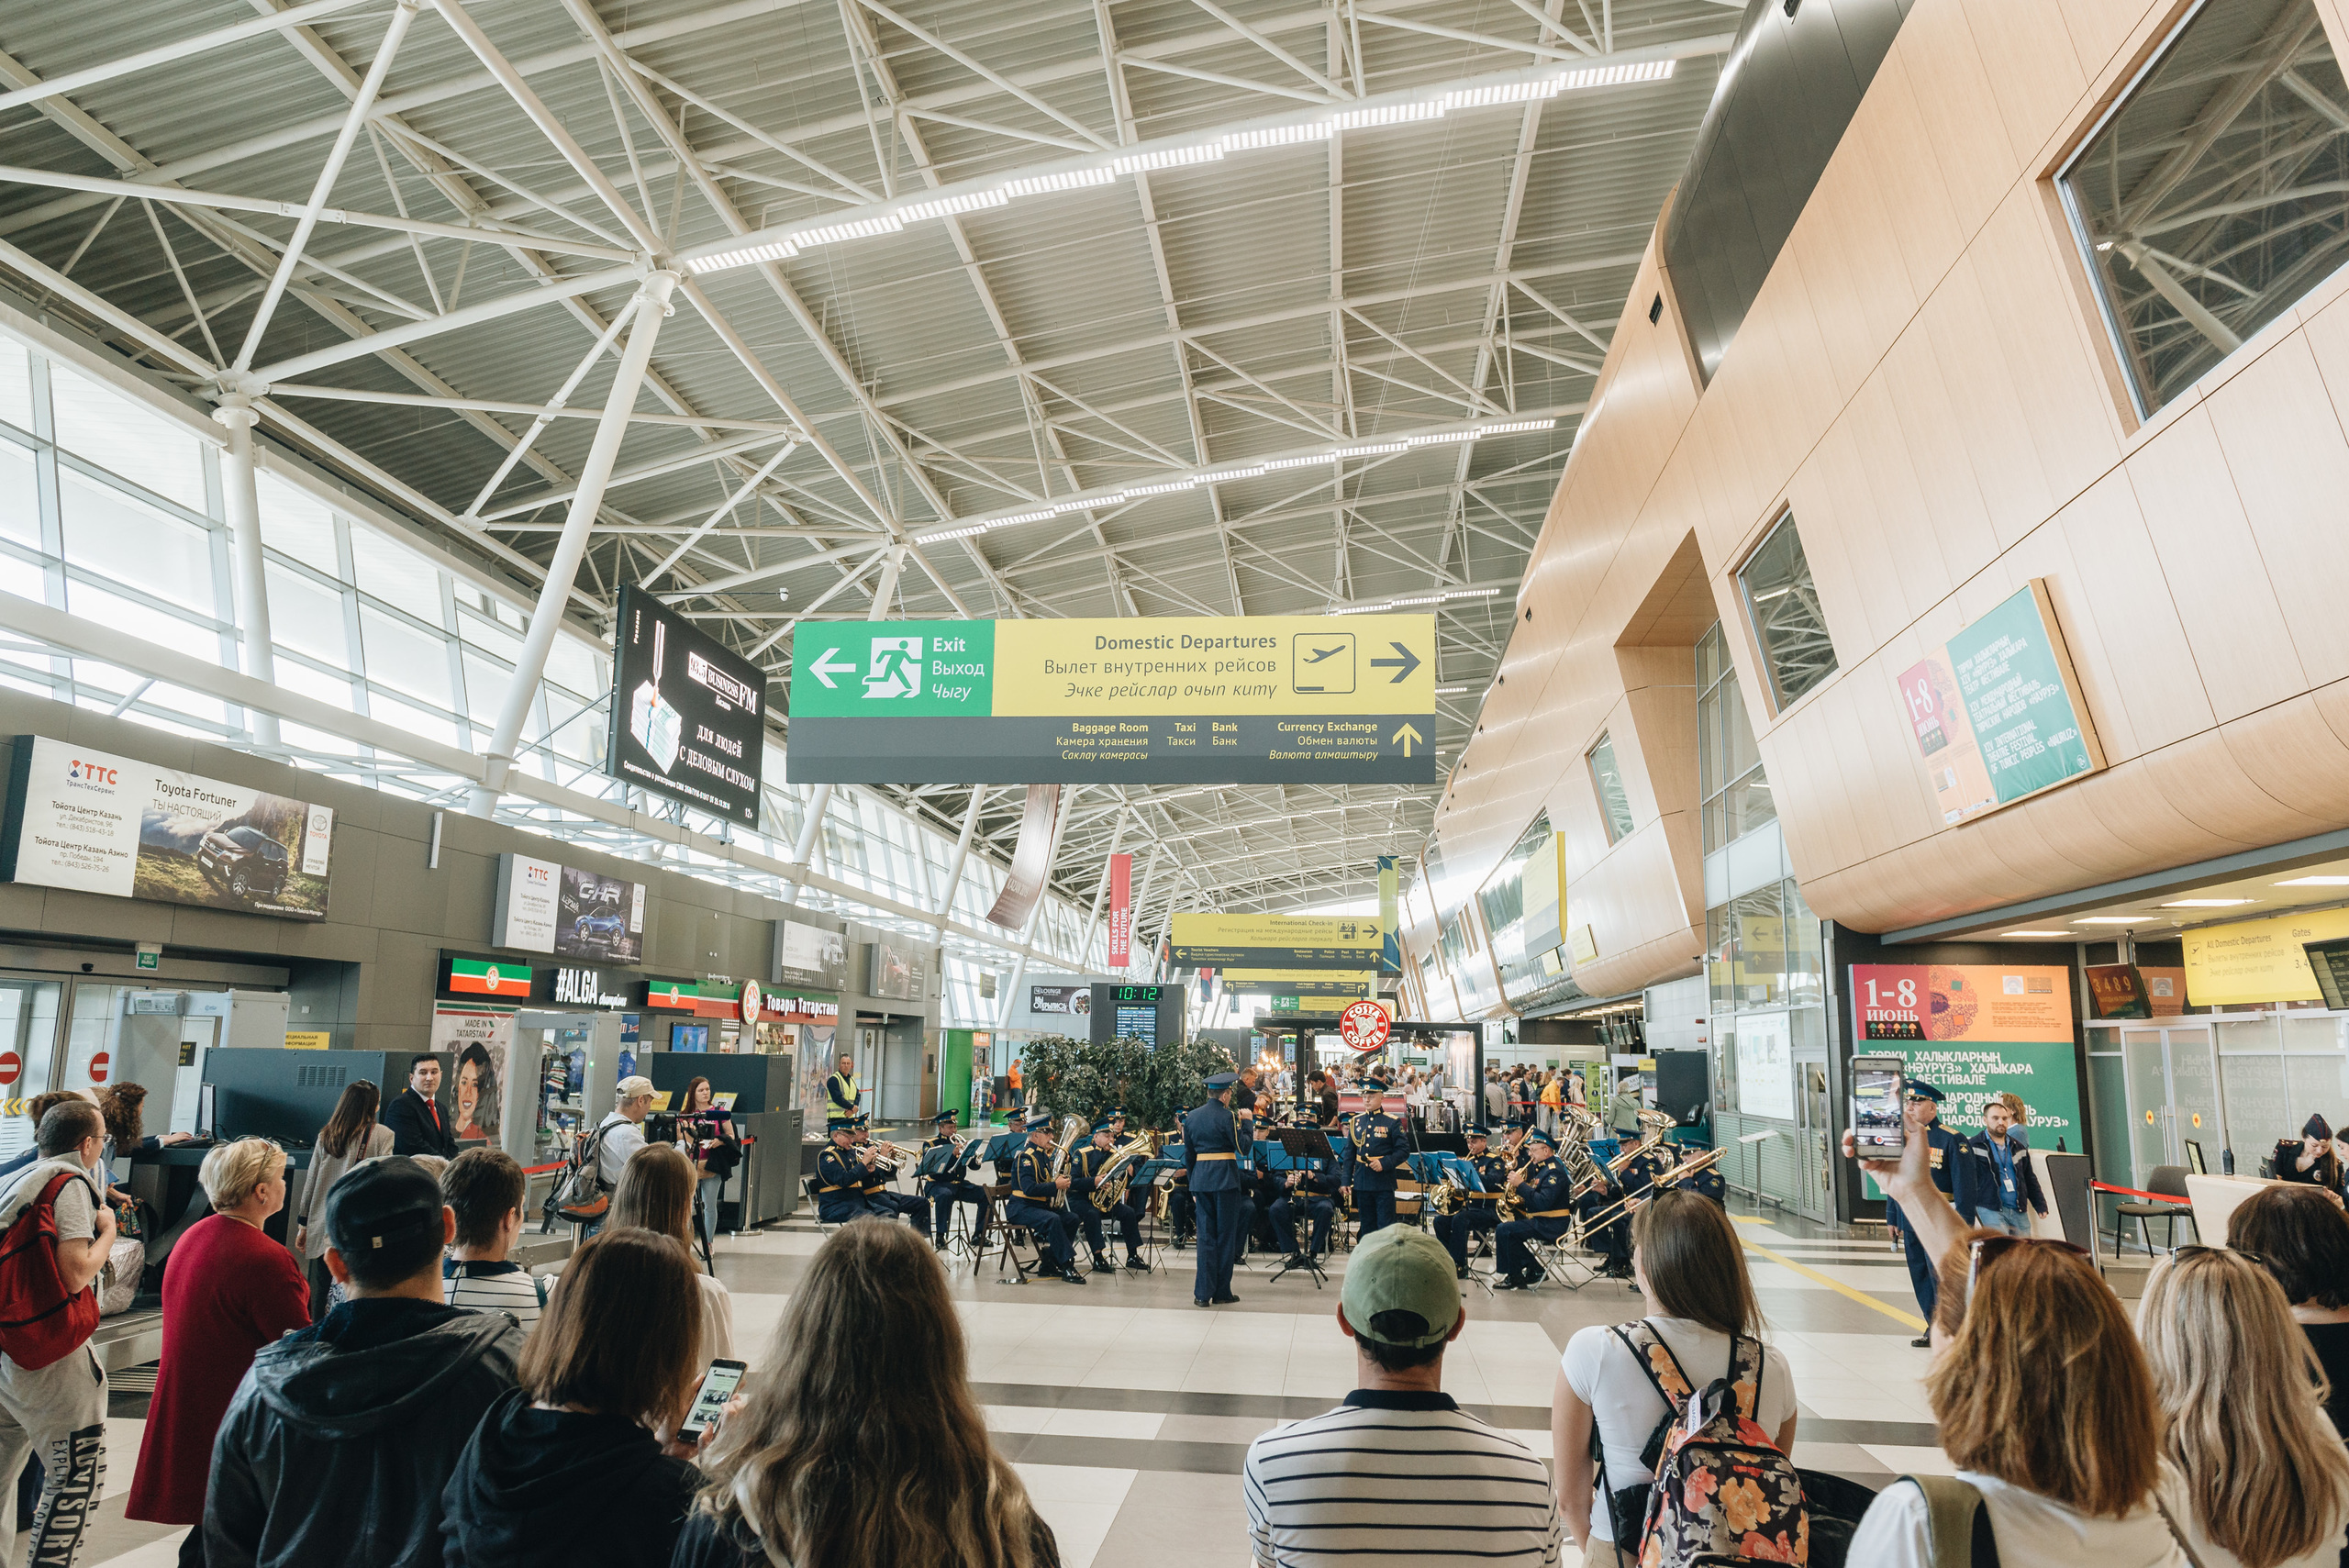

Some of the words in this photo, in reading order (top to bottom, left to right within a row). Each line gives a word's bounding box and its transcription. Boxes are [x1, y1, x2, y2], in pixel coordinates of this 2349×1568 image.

[932, 637, 966, 652] Exit
[1095, 635, 1174, 651] Domestic
[1180, 634, 1277, 653] Departures
[932, 660, 985, 677] Выход
[1044, 659, 1097, 674] Вылет
[1104, 661, 1208, 677] внутренних
[1214, 658, 1277, 675] рейсов
[707, 668, 739, 699] BUSINESS
[739, 682, 758, 716] FM
[931, 684, 972, 702] Чыгу
[1064, 683, 1103, 697] Эчке
[1108, 683, 1178, 700] рейслар
[1184, 684, 1226, 697] очып
[1232, 684, 1277, 699] китү
[1964, 679, 1979, 696] ТЕАТР
[2008, 679, 2041, 704] ФЕСТИВАЛЬ
[1905, 678, 1933, 722] 1-8
[2001, 699, 2027, 720] НАРОДОВ
[2029, 684, 2060, 706] «НАУРУЗ»
[1072, 723, 1117, 734] Baggage
[1119, 723, 1149, 732] Room
[1174, 722, 1197, 732] Taxi
[1211, 722, 1238, 732] Bank
[1277, 722, 1324, 733] Currency
[1327, 721, 1378, 733] Exchange
[1916, 715, 1940, 738] ИЮНЬ
[1994, 719, 2037, 749] INTERNATIONAL
[715, 733, 742, 759] людей
[1056, 737, 1095, 748] Камера
[1098, 738, 1149, 748] хранения
[1166, 736, 1197, 746] Такси
[1212, 736, 1238, 746] Банк
[1297, 736, 1333, 745] Обмен
[1337, 737, 1378, 745] валюты
[1987, 744, 2010, 764] THEATRE
[2009, 732, 2037, 753] FESTIVAL
[1062, 750, 1097, 762] Саклау
[1099, 751, 1149, 762] камерасы
[1269, 750, 1311, 760] Валюта
[1314, 751, 1379, 761] алмаштыру
[1990, 763, 1998, 774] OF
[1998, 752, 2021, 771] TURKIC
[2020, 740, 2045, 761] PEOPLES
[2047, 728, 2077, 748] «NAURUZ»
[679, 745, 686, 761] С
[685, 748, 726, 780] ДЕЛОВЫМ
[726, 767, 755, 792] СЛУХОМ
[66, 779, 116, 795] ТрансТехСервис
[155, 779, 191, 798] Toyota
[193, 788, 237, 808] Fortuner
[51, 800, 76, 812] Тойота
[77, 806, 98, 817] Центр
[99, 809, 123, 821] Казань
[152, 799, 165, 811] ТЫ
[166, 802, 222, 822] НАСТОЯЩИЙ
[744, 807, 753, 819] 12+
[70, 823, 85, 832] (843)
[85, 826, 115, 837] 518-43-18
[309, 830, 328, 840] TOYOTA
[34, 835, 60, 848] Тойота
[60, 840, 83, 852] Центр
[83, 844, 106, 855] Казань
[107, 848, 128, 859] Азино
[64, 860, 81, 870] (843)
[81, 863, 110, 873] 526-75-26
[1119, 906, 1129, 936] FUTURE
[1111, 928, 1119, 955] SKILLS
[1119, 938, 1129, 955] THE
[2215, 938, 2240, 949] Domestic
[2240, 934, 2272, 946] Departures
[2291, 929, 2311, 938] Gates
[2264, 948, 2285, 958] рейсов
[555, 967, 598, 1005] #ALGA
[1864, 978, 1918, 1008] 1-8
[2092, 978, 2102, 994] 3
[2104, 977, 2111, 992] 4
[2112, 976, 2121, 992] 8
[2122, 975, 2132, 991] 9
[1119, 986, 1158, 1001] 10:12
[766, 994, 796, 1017] Товары
[797, 996, 839, 1018] Татарстана
[1348, 1005, 1381, 1019] COSTA
[464, 1019, 481, 1028] MADE
[1866, 1009, 1920, 1021] ИЮНЬ
[456, 1029, 486, 1039] TATARSTAN
[1346, 1029, 1385, 1047] COFFEE
[1970, 1062, 2033, 1074] ХАЛЫКАРА
[1916, 1073, 1987, 1085] ФЕСТИВАЛЕ
[38, 1436, 101, 1566] ADVISORY
